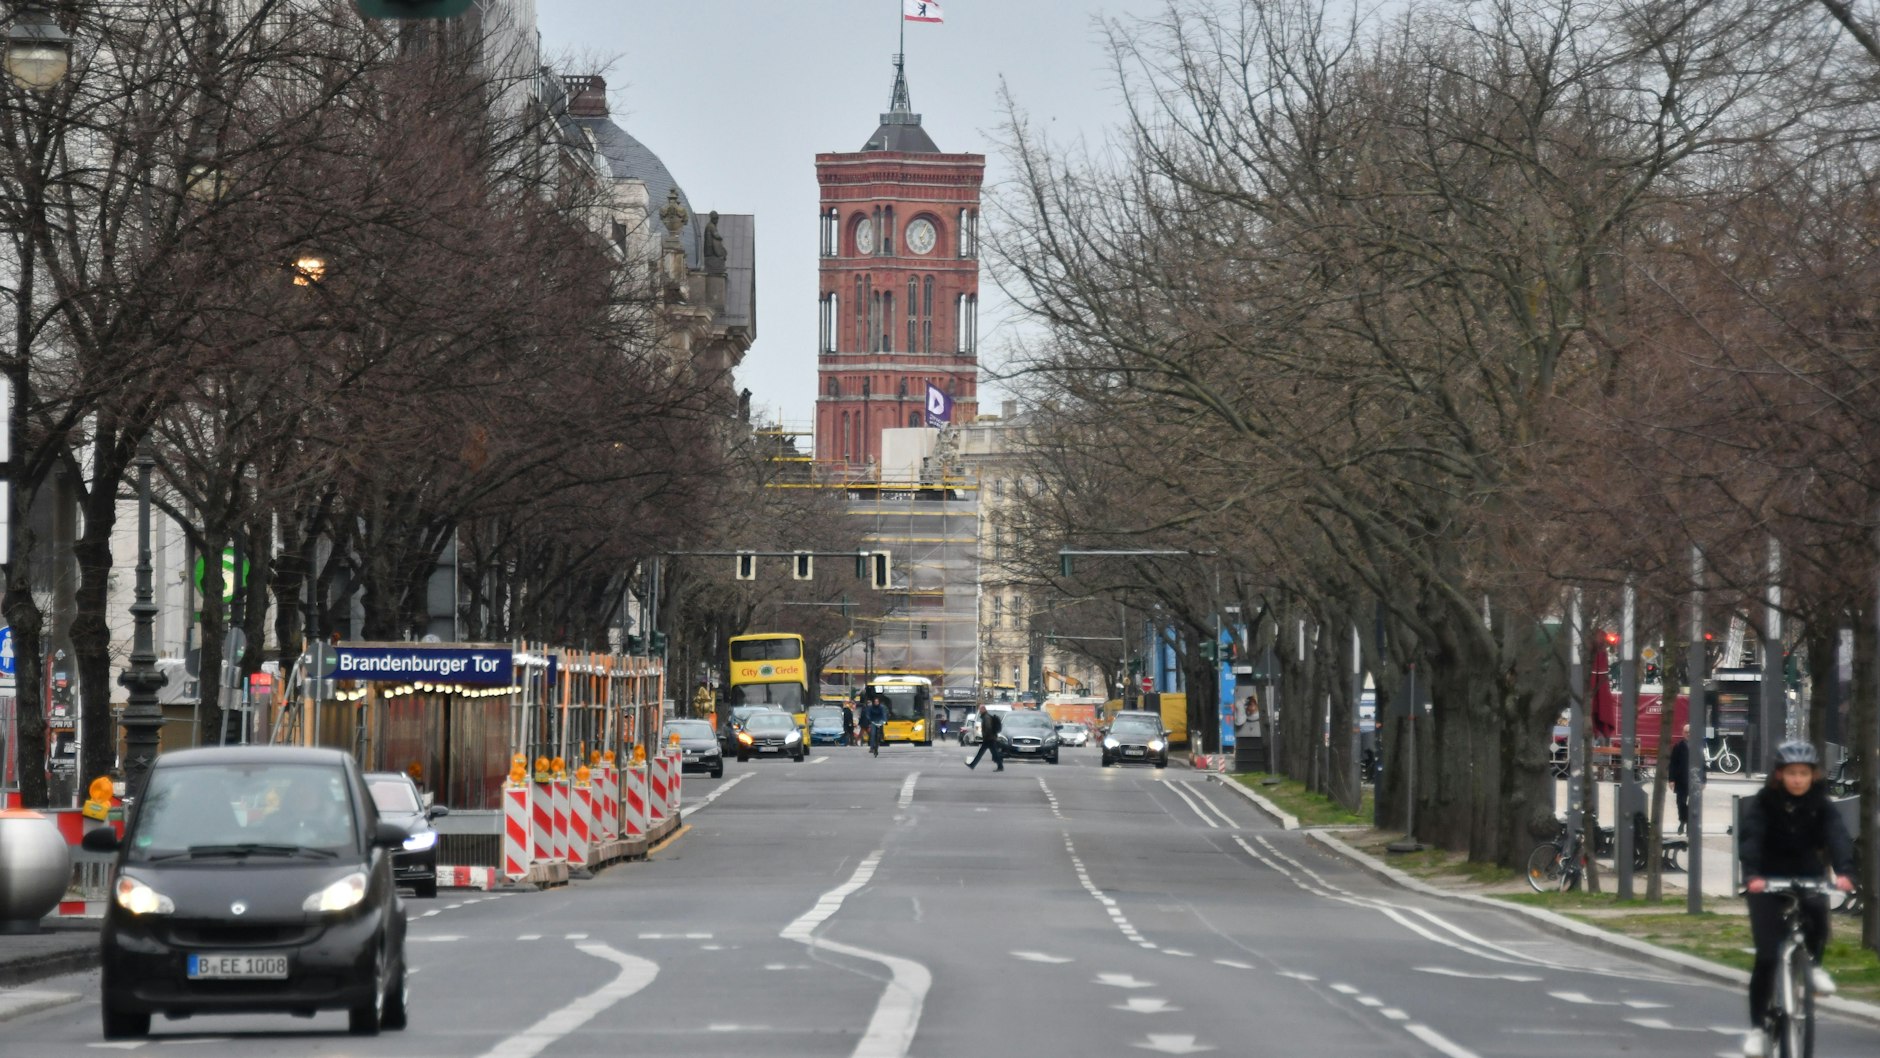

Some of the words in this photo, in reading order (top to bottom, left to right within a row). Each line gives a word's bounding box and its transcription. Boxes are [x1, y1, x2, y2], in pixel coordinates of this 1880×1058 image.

[340, 654, 468, 675] Brandenburger
[472, 656, 499, 673] Tor
[741, 669, 758, 678] City
[775, 666, 799, 674] Circle
[199, 958, 209, 974] B
[220, 958, 241, 974] EE
[246, 958, 286, 974] 1008
